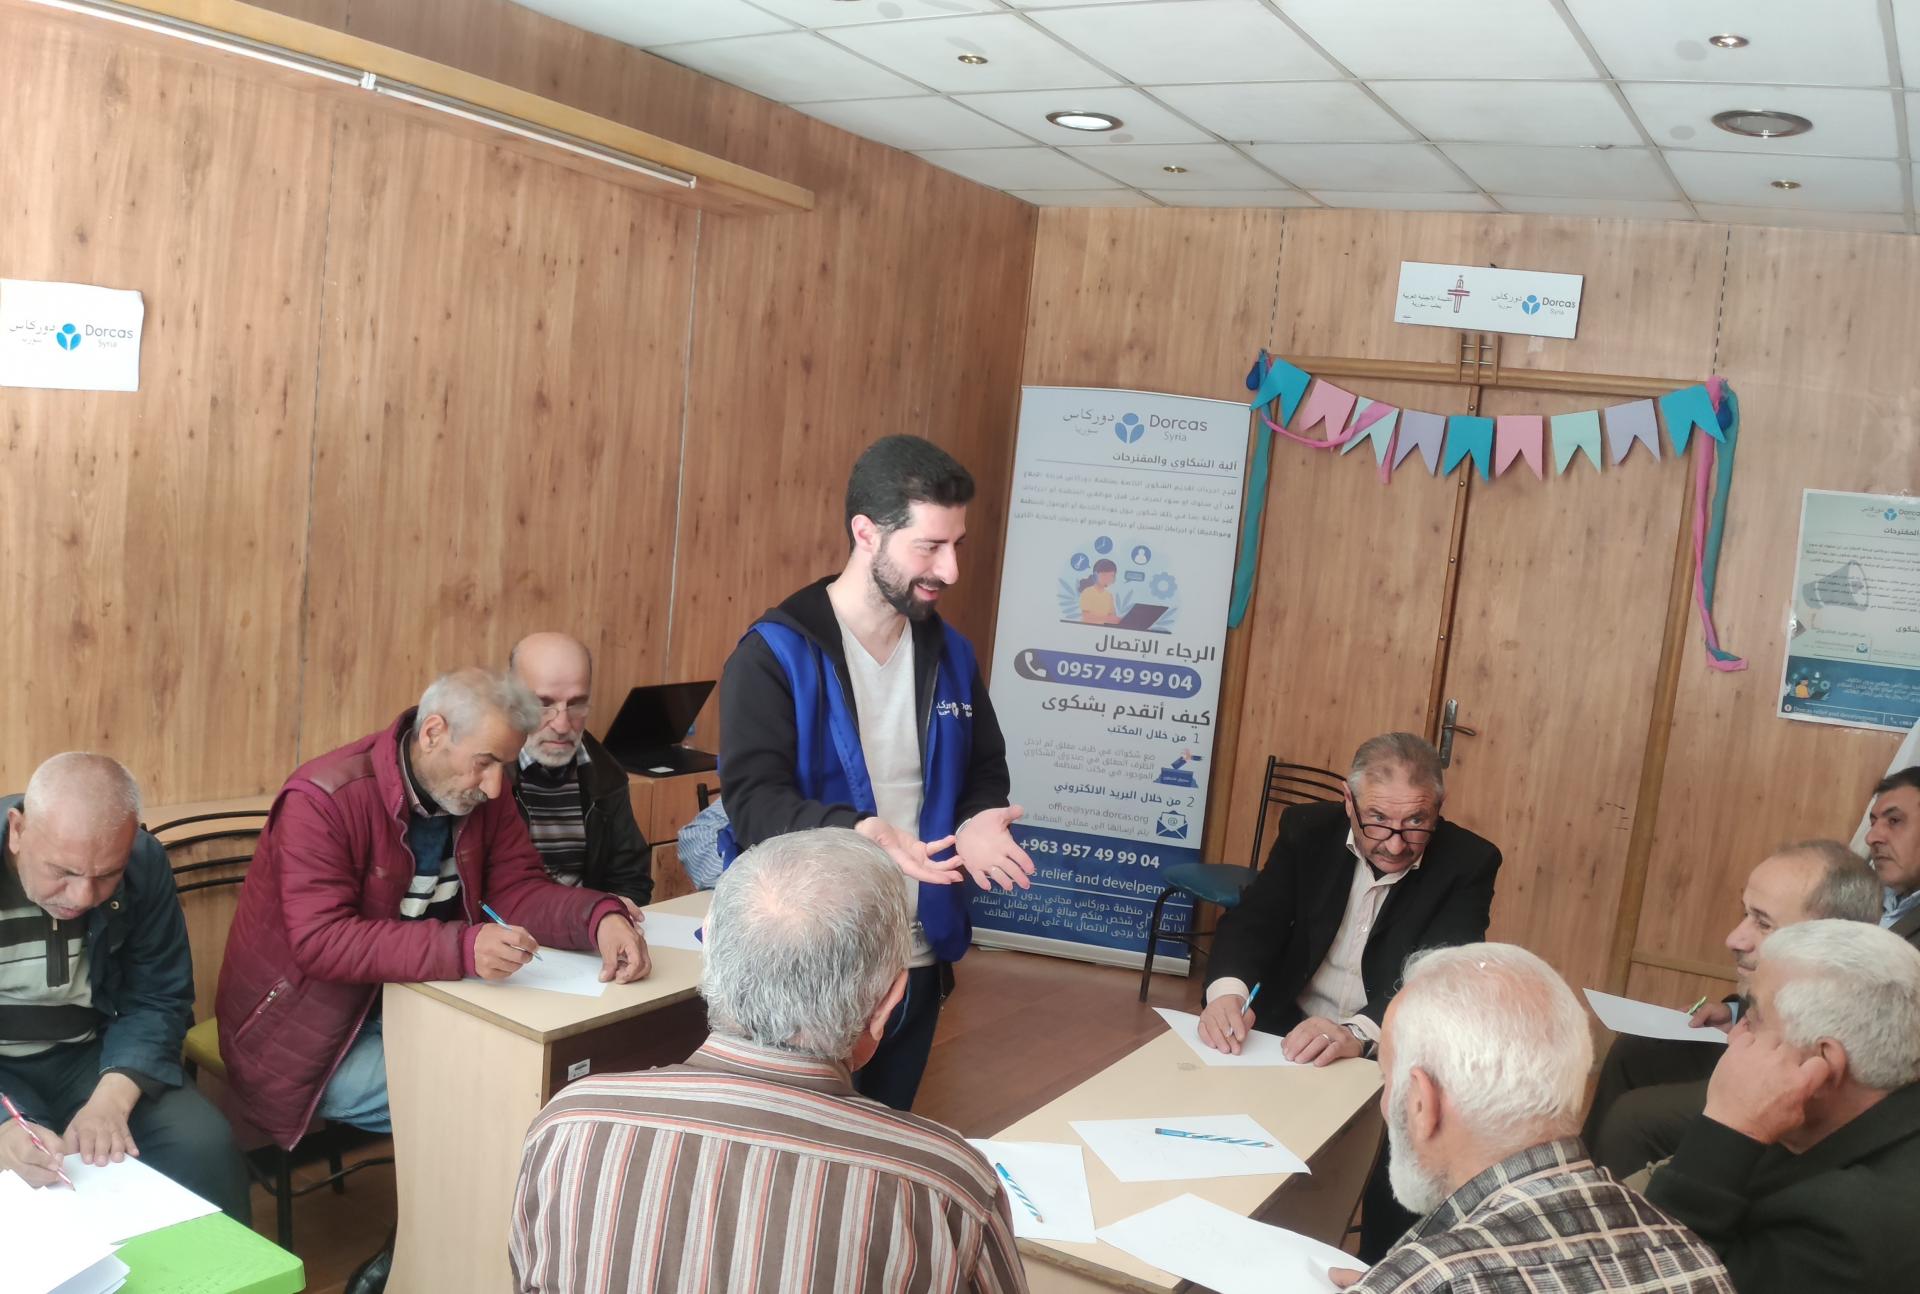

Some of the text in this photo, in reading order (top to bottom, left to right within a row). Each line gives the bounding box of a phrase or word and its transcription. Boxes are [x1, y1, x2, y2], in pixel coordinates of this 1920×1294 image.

[1542, 297, 1576, 309] Dorcas
[8, 319, 56, 336] دوركاس
[85, 323, 134, 340] Dorcas
[1062, 407, 1115, 426] دوركاس
[1149, 414, 1208, 432] Dorcas
[1163, 431, 1188, 444] Syria
[1111, 450, 1167, 468] والمقترحات
[1095, 634, 1217, 664] الرجاء الإتصال
[1056, 660, 1193, 692] 0957 49 99 04
[1042, 694, 1211, 729] كيف أتقدم بشكوى
[1106, 724, 1143, 738] المكتب
[1145, 728, 1168, 741] خلال
[1171, 733, 1188, 744] من
[1108, 788, 1137, 802] البريد
[1140, 792, 1163, 805] خلال
[1166, 797, 1182, 808] من
[1186, 796, 1195, 808] 2
[1020, 838, 1161, 870] +963 957 49 99 04
[1041, 866, 1074, 881] relief
[1075, 873, 1099, 886] and
[972, 894, 1002, 906] استلام
[1020, 892, 1042, 902] بدون
[1045, 895, 1072, 906] مجاني
[1003, 899, 1028, 910] مقابل
[1074, 898, 1111, 913] دوركاس
[1113, 904, 1144, 916] منظمة
[984, 907, 1015, 920] الهاتف
[1018, 911, 1040, 925] أرقام
[1056, 907, 1078, 918] مبالغ
[1080, 911, 1104, 921] منكم
[1041, 916, 1059, 928] على
[1076, 921, 1109, 934] الاتصال
[1106, 916, 1133, 926] شخص
[1110, 929, 1134, 939] يرجى
